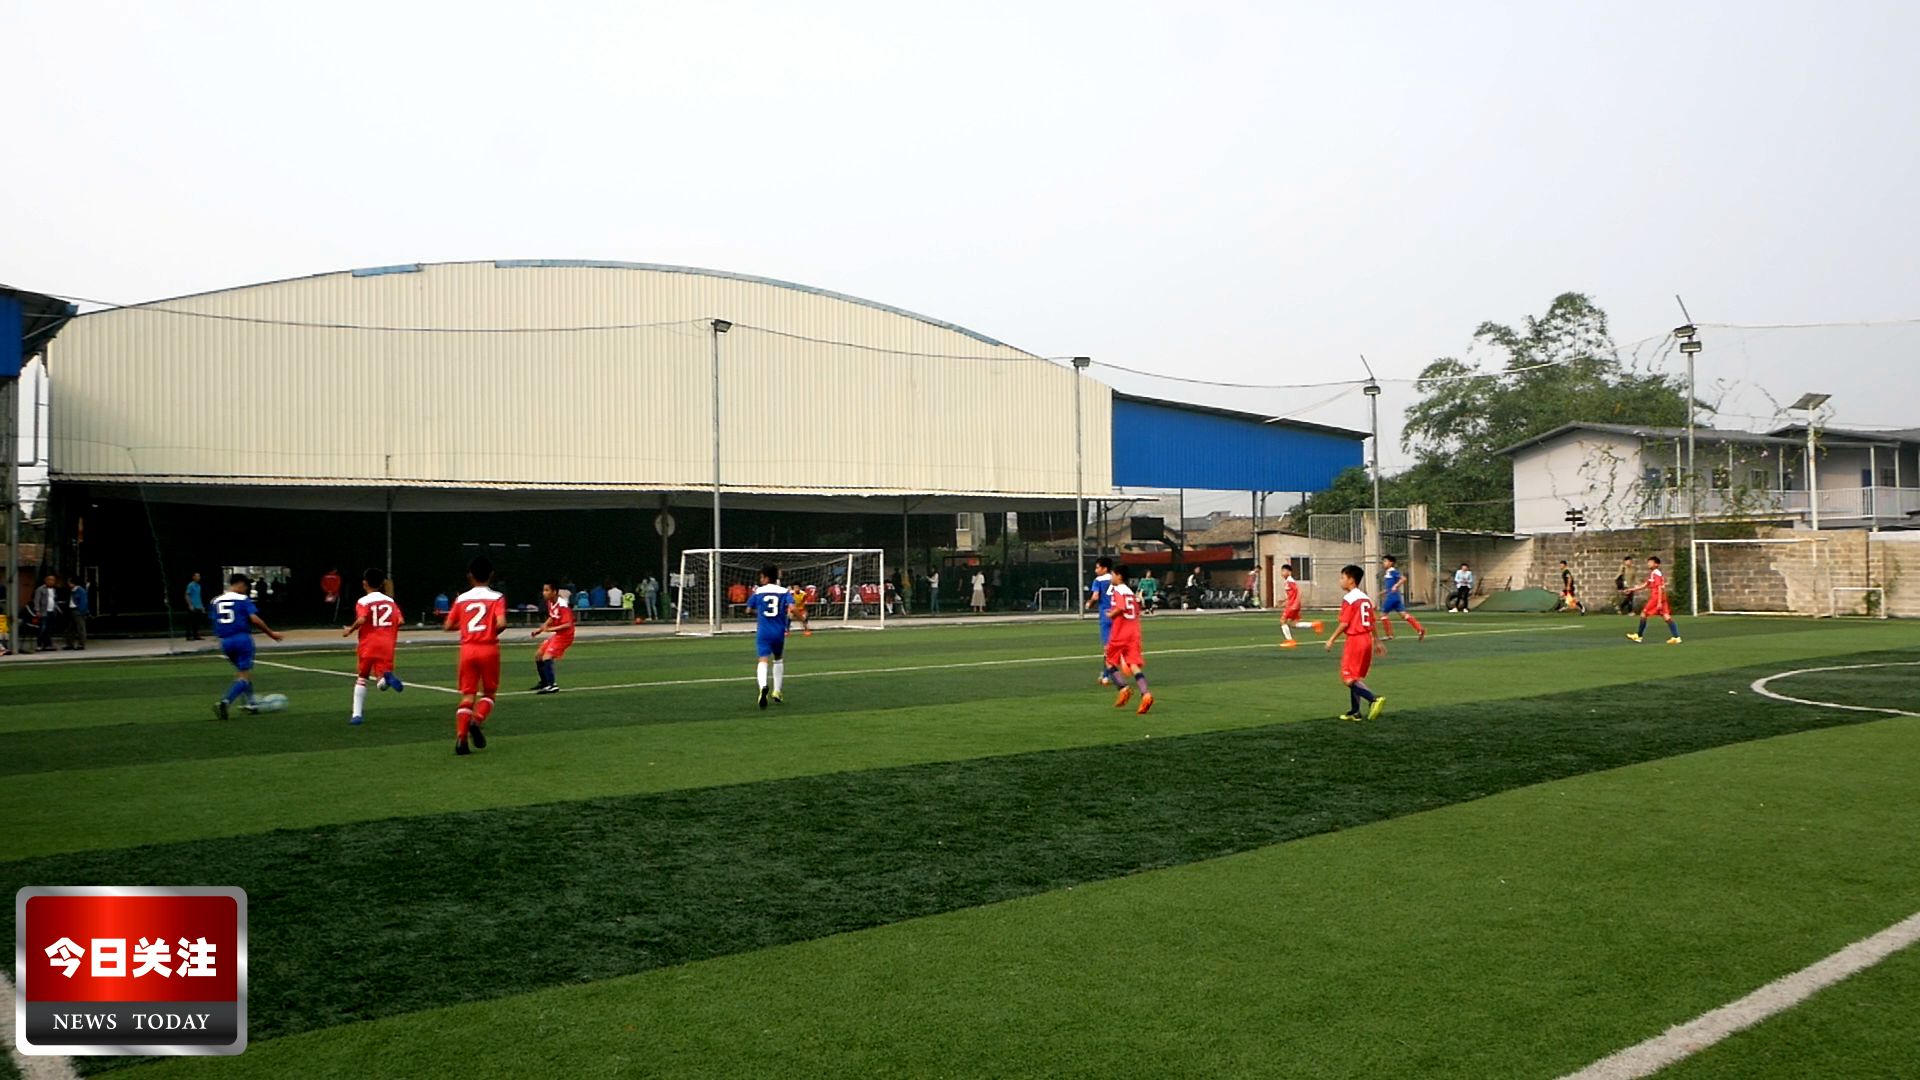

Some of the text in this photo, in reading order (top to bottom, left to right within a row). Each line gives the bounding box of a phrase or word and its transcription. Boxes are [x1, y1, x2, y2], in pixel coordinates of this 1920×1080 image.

[217, 602, 235, 623] 5
[370, 604, 393, 626] 12
[466, 602, 487, 631] 2
[763, 595, 779, 617] 3
[1124, 597, 1135, 619] 5
